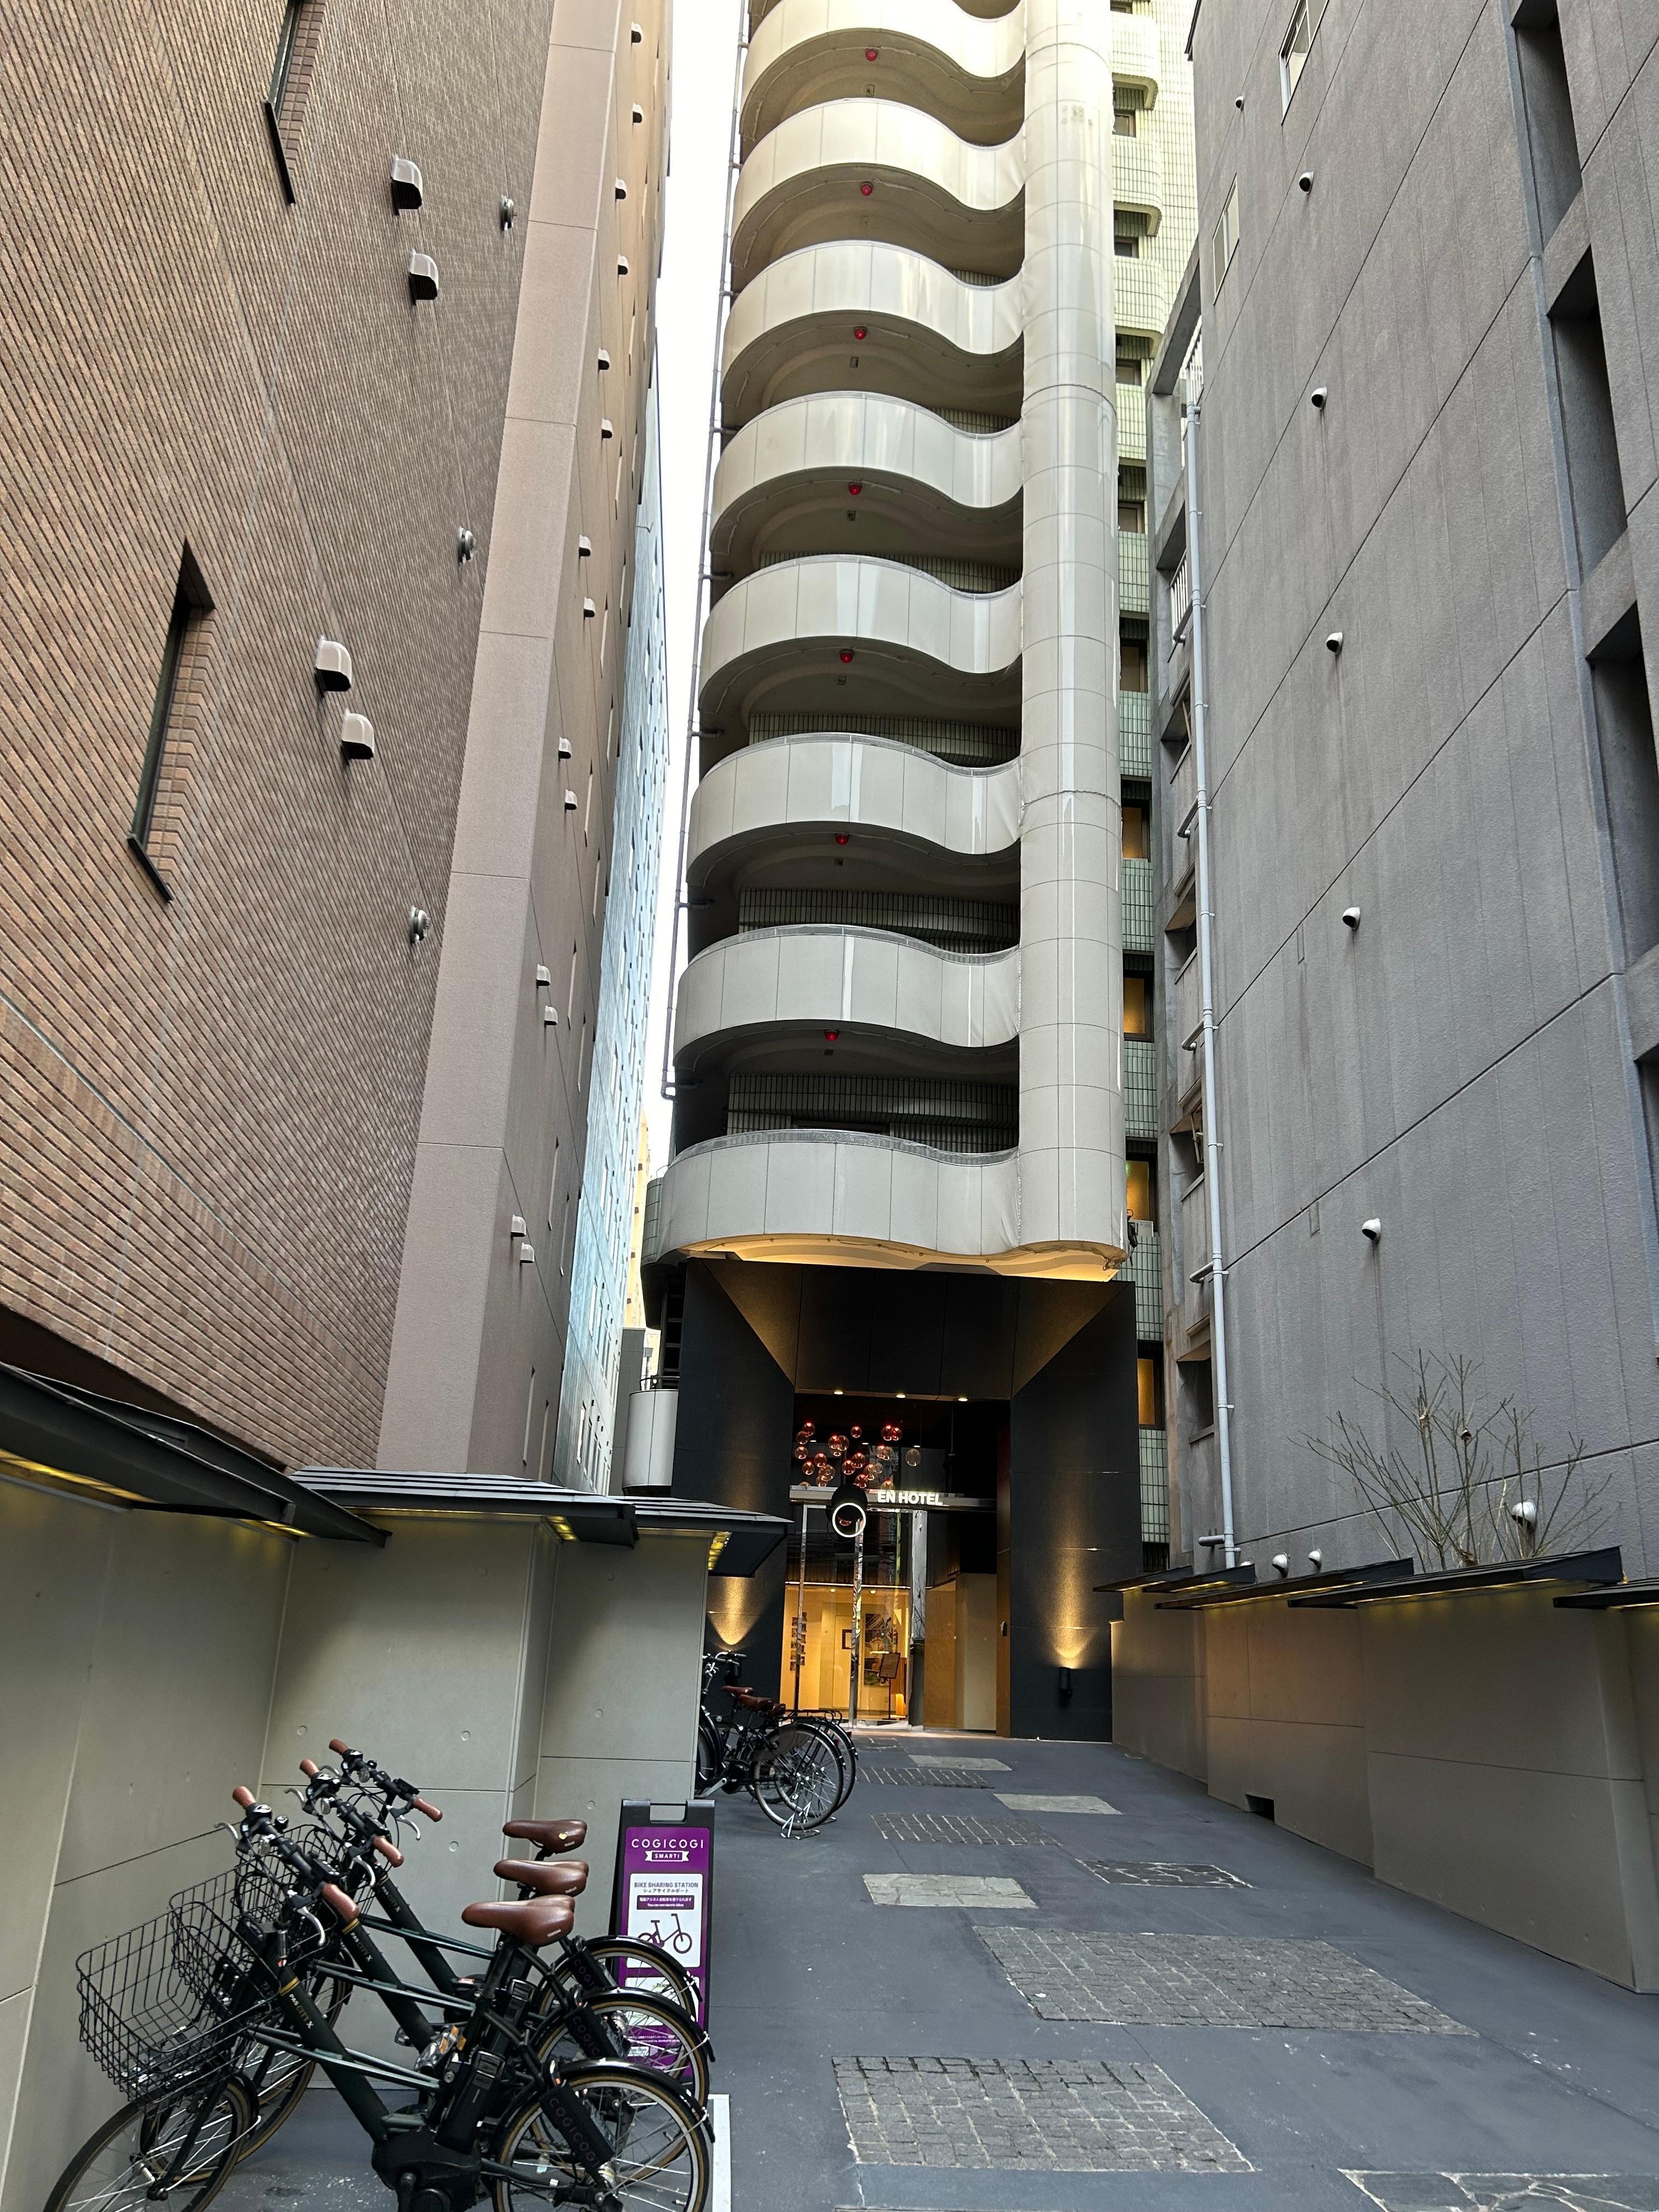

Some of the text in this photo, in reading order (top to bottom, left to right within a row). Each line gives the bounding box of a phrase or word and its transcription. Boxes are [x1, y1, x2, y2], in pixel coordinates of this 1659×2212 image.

[877, 1489, 943, 1505] EN HOTEL
[631, 1838, 703, 1849] COGICOGI
[289, 1994, 299, 2006] PAS
[306, 2021, 314, 2029] X
